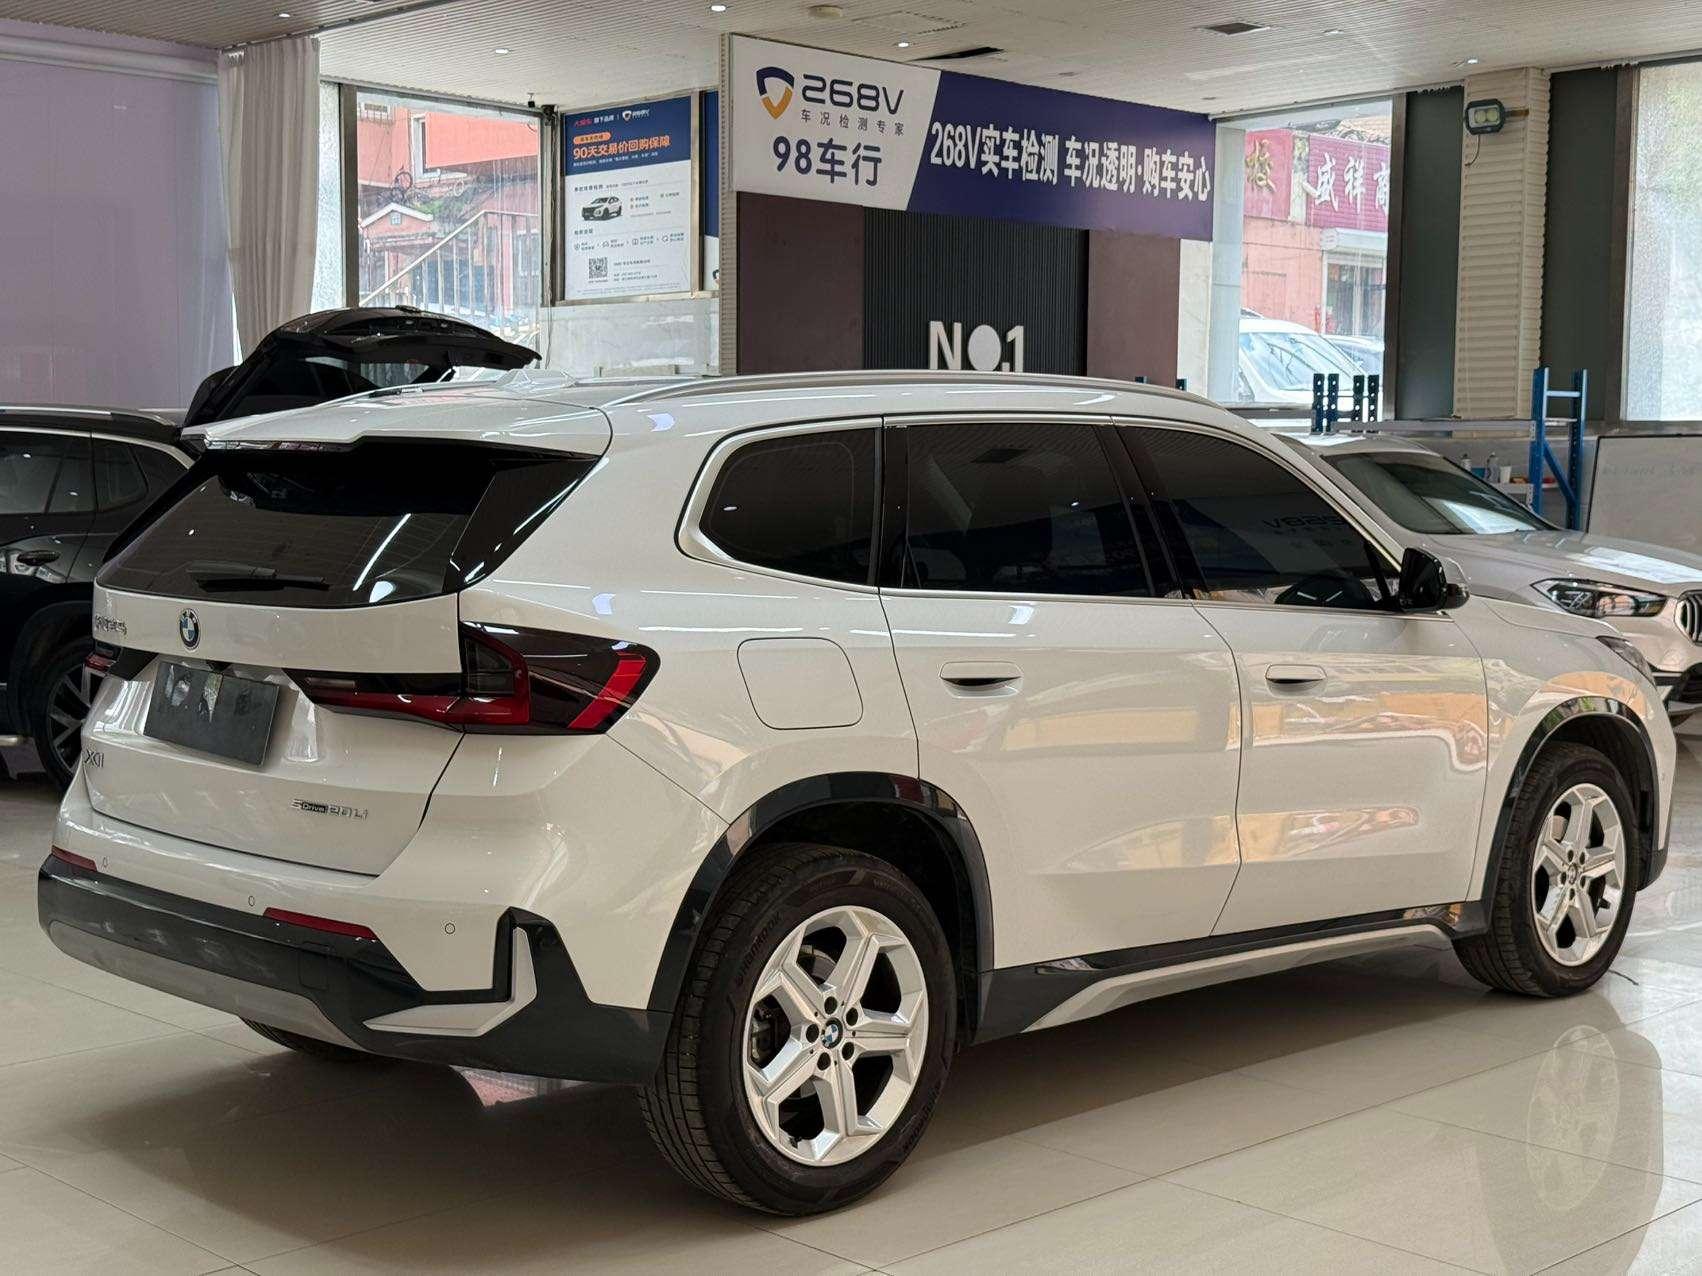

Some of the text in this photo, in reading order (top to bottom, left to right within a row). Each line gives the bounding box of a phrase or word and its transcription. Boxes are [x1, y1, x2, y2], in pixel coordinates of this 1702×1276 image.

[801, 73, 904, 115] 268V
[801, 109, 904, 137] 车况检测专家
[573, 135, 670, 160] 90天交易价回购保障
[773, 135, 882, 186] 98车行
[930, 121, 1211, 201] 268V实车检测 车况透明·购车安心
